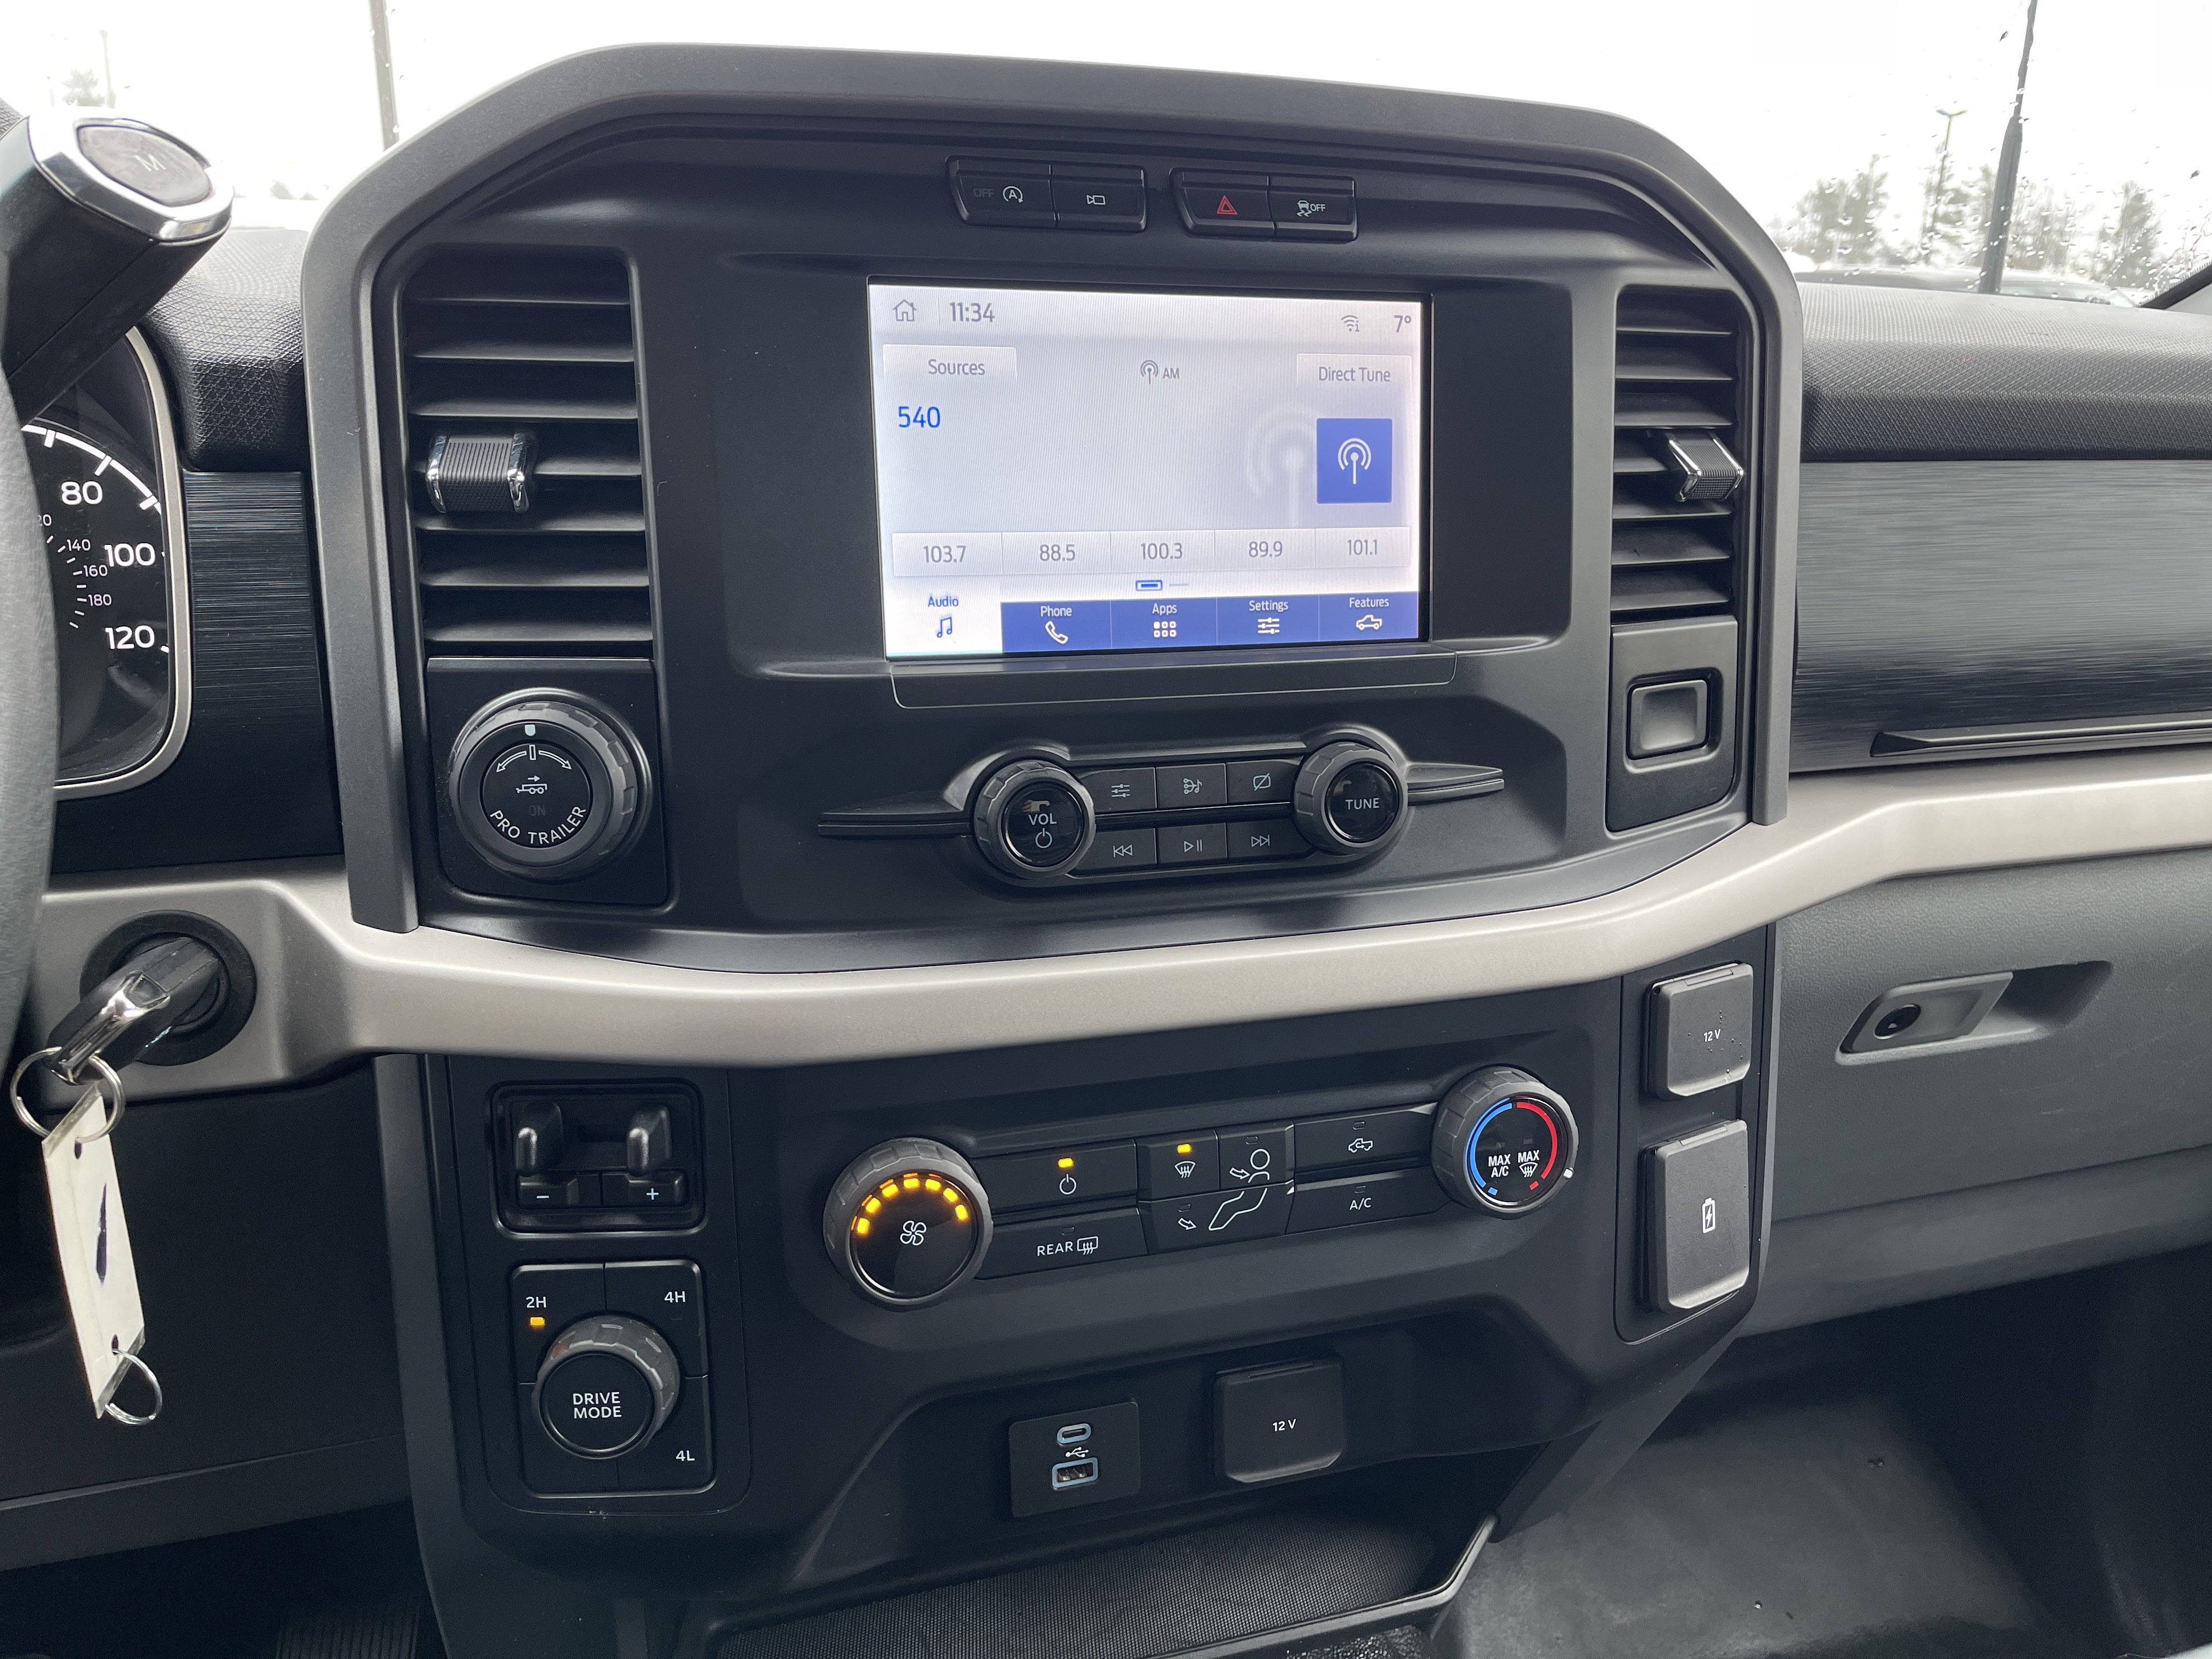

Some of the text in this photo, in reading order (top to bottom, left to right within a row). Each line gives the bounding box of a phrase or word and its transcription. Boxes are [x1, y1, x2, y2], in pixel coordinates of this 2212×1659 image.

[134, 154, 167, 171] M
[973, 188, 995, 198] OFF
[1310, 204, 1325, 212] OFF
[950, 302, 995, 323] 11:34
[928, 359, 985, 376] Sources
[1163, 367, 1180, 380] AM
[1318, 366, 1391, 382] Direct Tune
[898, 406, 940, 429] 540
[61, 481, 103, 505] 80
[67, 539, 91, 551] 140
[1140, 542, 1183, 560] 100.3
[1248, 540, 1283, 557] 89.9
[1347, 539, 1378, 556] 101.1
[104, 543, 155, 567] 100
[923, 545, 966, 563] 103.7
[1039, 544, 1075, 561] 88.5
[83, 565, 108, 577] 160
[88, 594, 111, 606] 180
[927, 595, 958, 608] Audio
[1249, 599, 1288, 613] Settings
[1348, 596, 1389, 608] Features
[1040, 605, 1072, 618] Phone
[1152, 602, 1177, 617] Apps
[105, 625, 155, 649] 120
[1345, 797, 1380, 810] TUNE
[529, 805, 545, 816] ON
[490, 806, 586, 844] PRO TRAILER
[1029, 814, 1056, 825] VOL
[1488, 1150, 1539, 1167] MAX MAX
[1491, 1166, 1509, 1177] A/C
[1350, 1198, 1371, 1210] A/C
[1037, 1242, 1074, 1256] REAR
[526, 1296, 546, 1309] 2H
[664, 1291, 686, 1304] 4H
[573, 1392, 620, 1405] DRIVE
[574, 1406, 622, 1418] MODE
[676, 1450, 695, 1462] 4L
